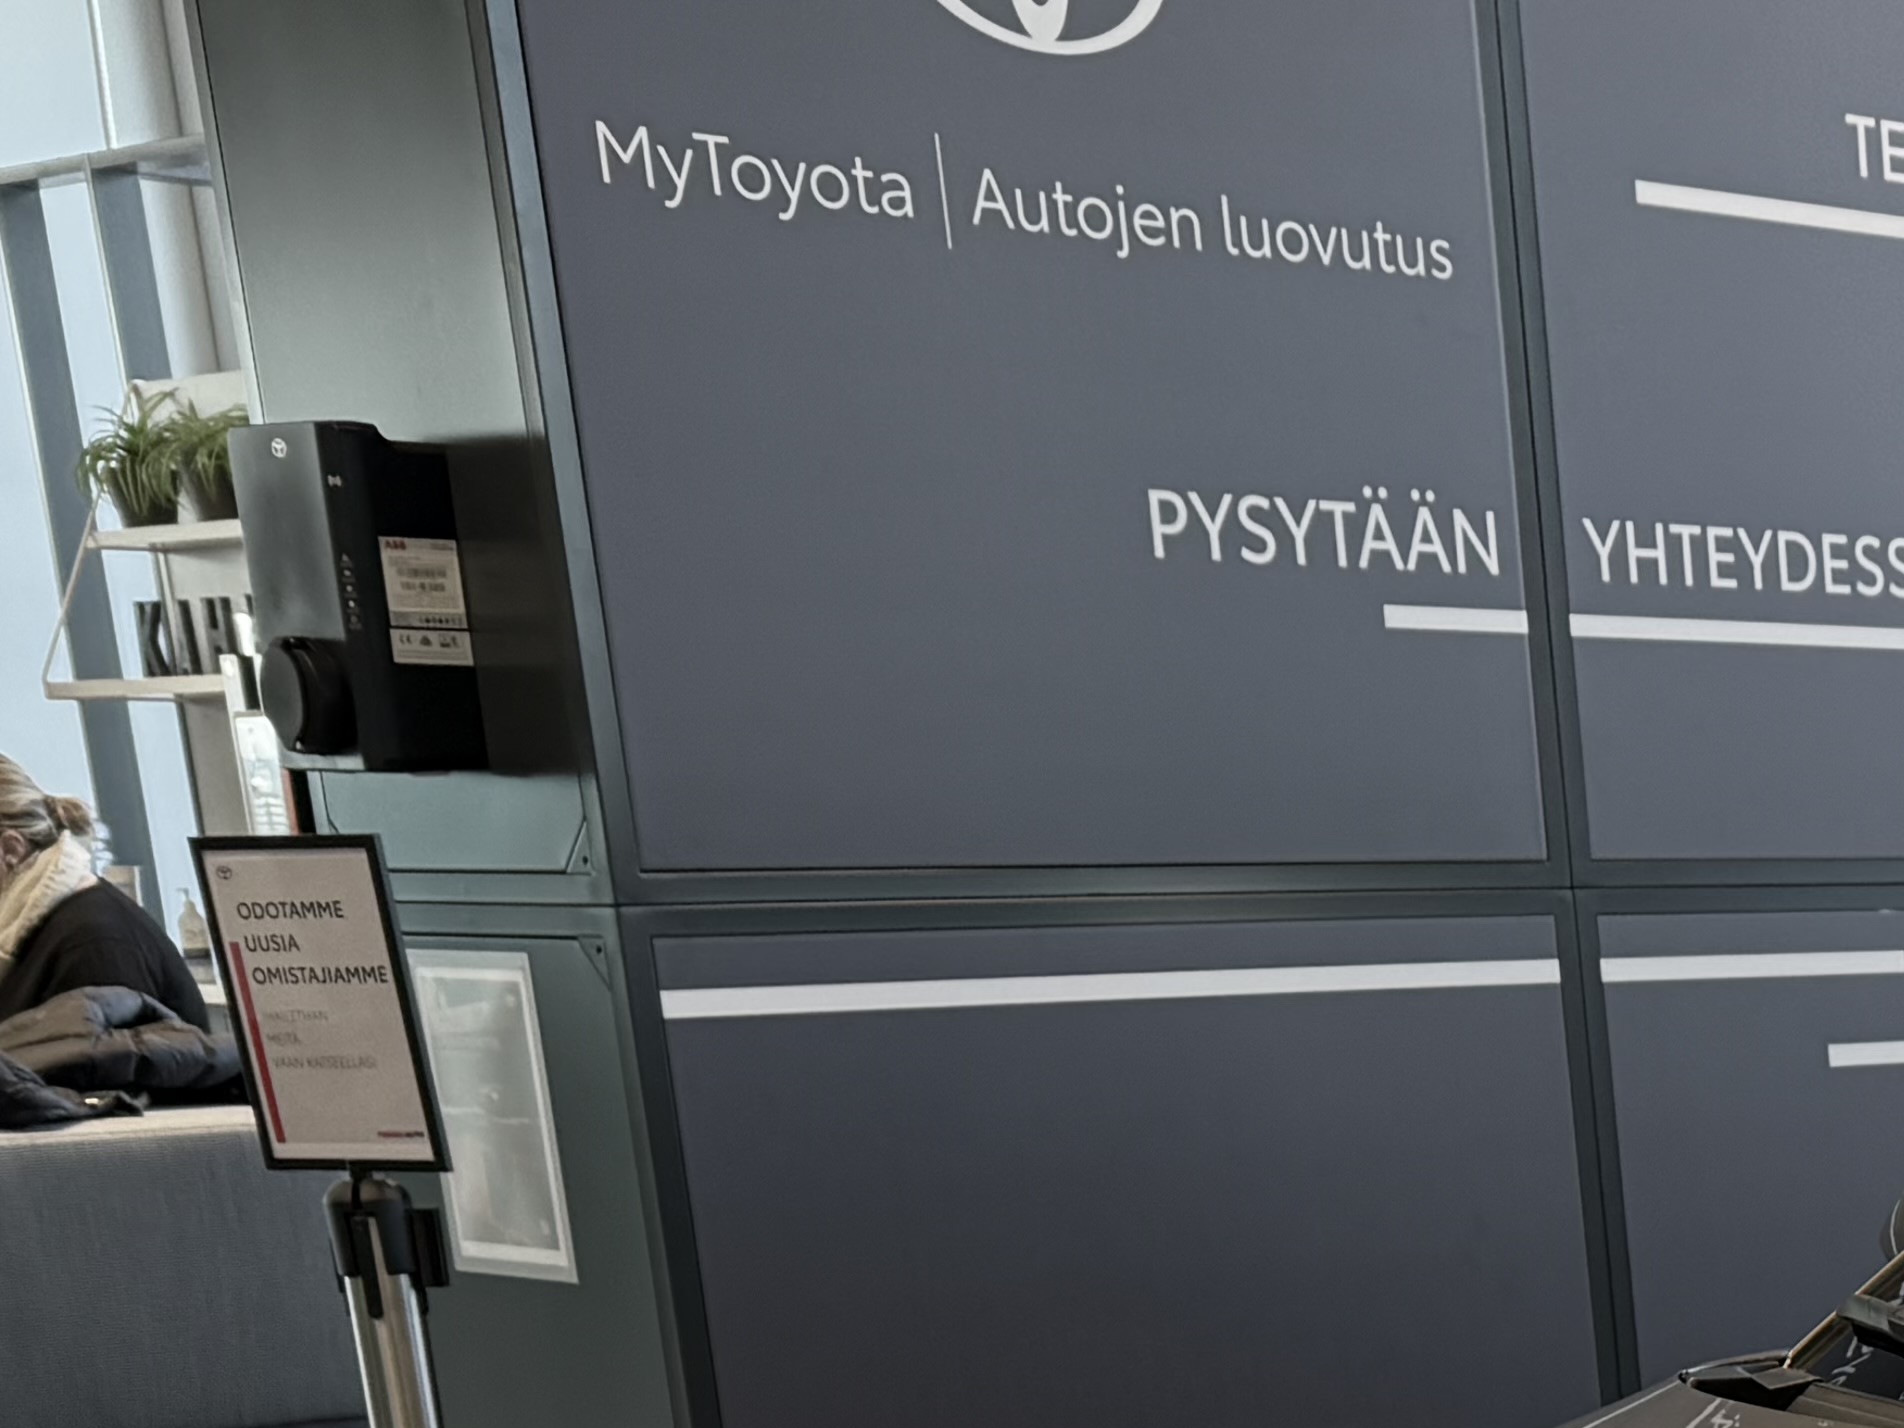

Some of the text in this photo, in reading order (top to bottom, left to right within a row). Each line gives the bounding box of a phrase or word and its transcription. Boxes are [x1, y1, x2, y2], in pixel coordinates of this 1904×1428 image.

[595, 120, 1454, 280] MyToyota Autojen luovutus
[1147, 485, 1500, 577] PYSYTÄÄN
[236, 899, 345, 921] ODOTAMME
[244, 933, 301, 954] UUSIA
[251, 964, 390, 986] OMISTAJIAMME
